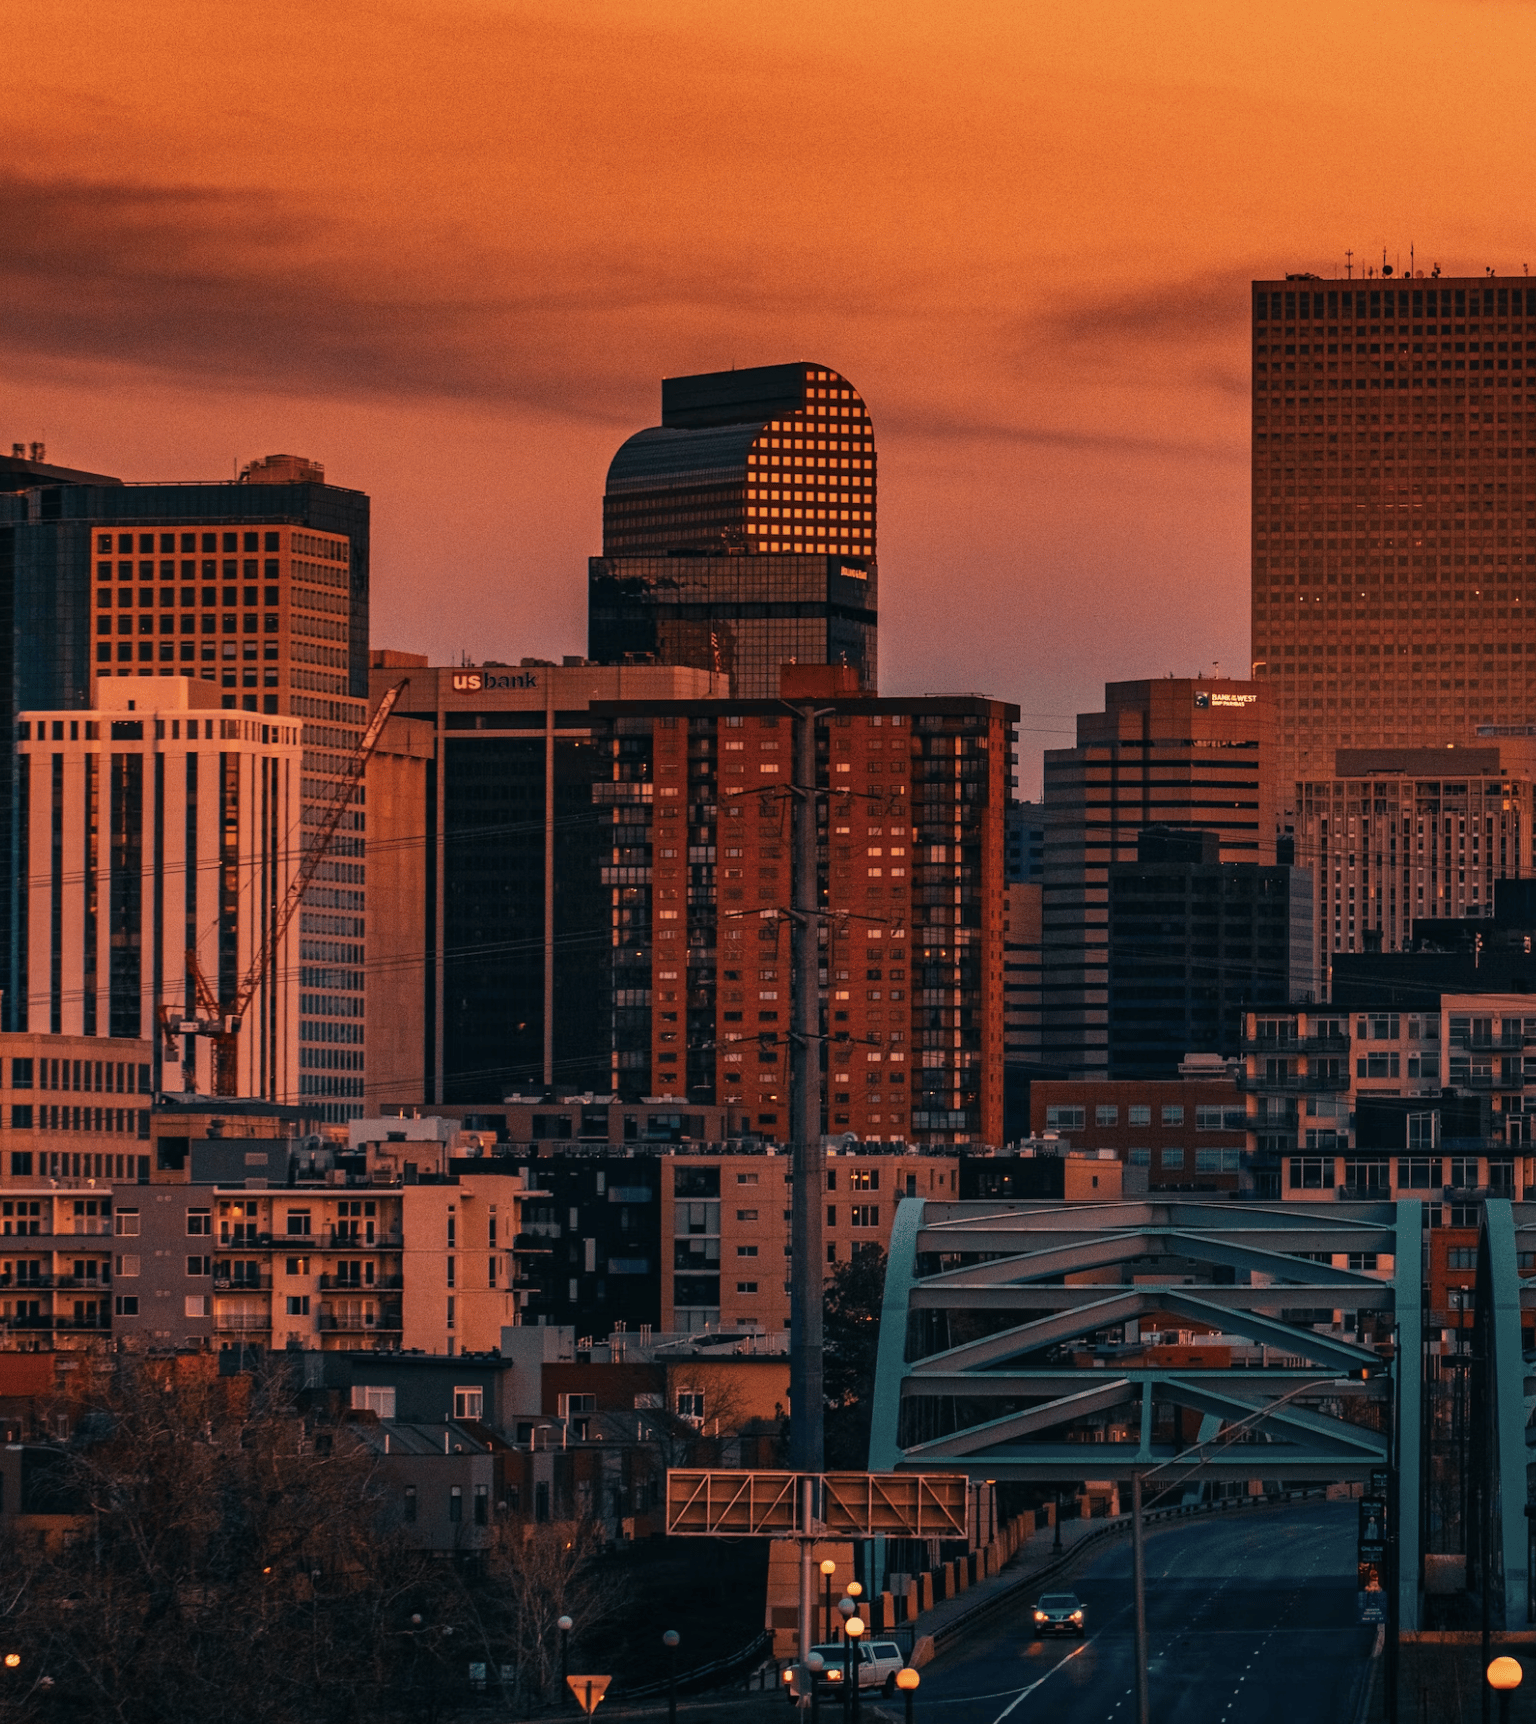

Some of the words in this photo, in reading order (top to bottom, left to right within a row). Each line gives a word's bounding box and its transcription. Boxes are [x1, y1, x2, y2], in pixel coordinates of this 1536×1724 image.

[454, 675, 481, 690] us
[485, 672, 537, 688] bank
[1211, 693, 1231, 701] BANK
[1237, 694, 1257, 702] WEST
